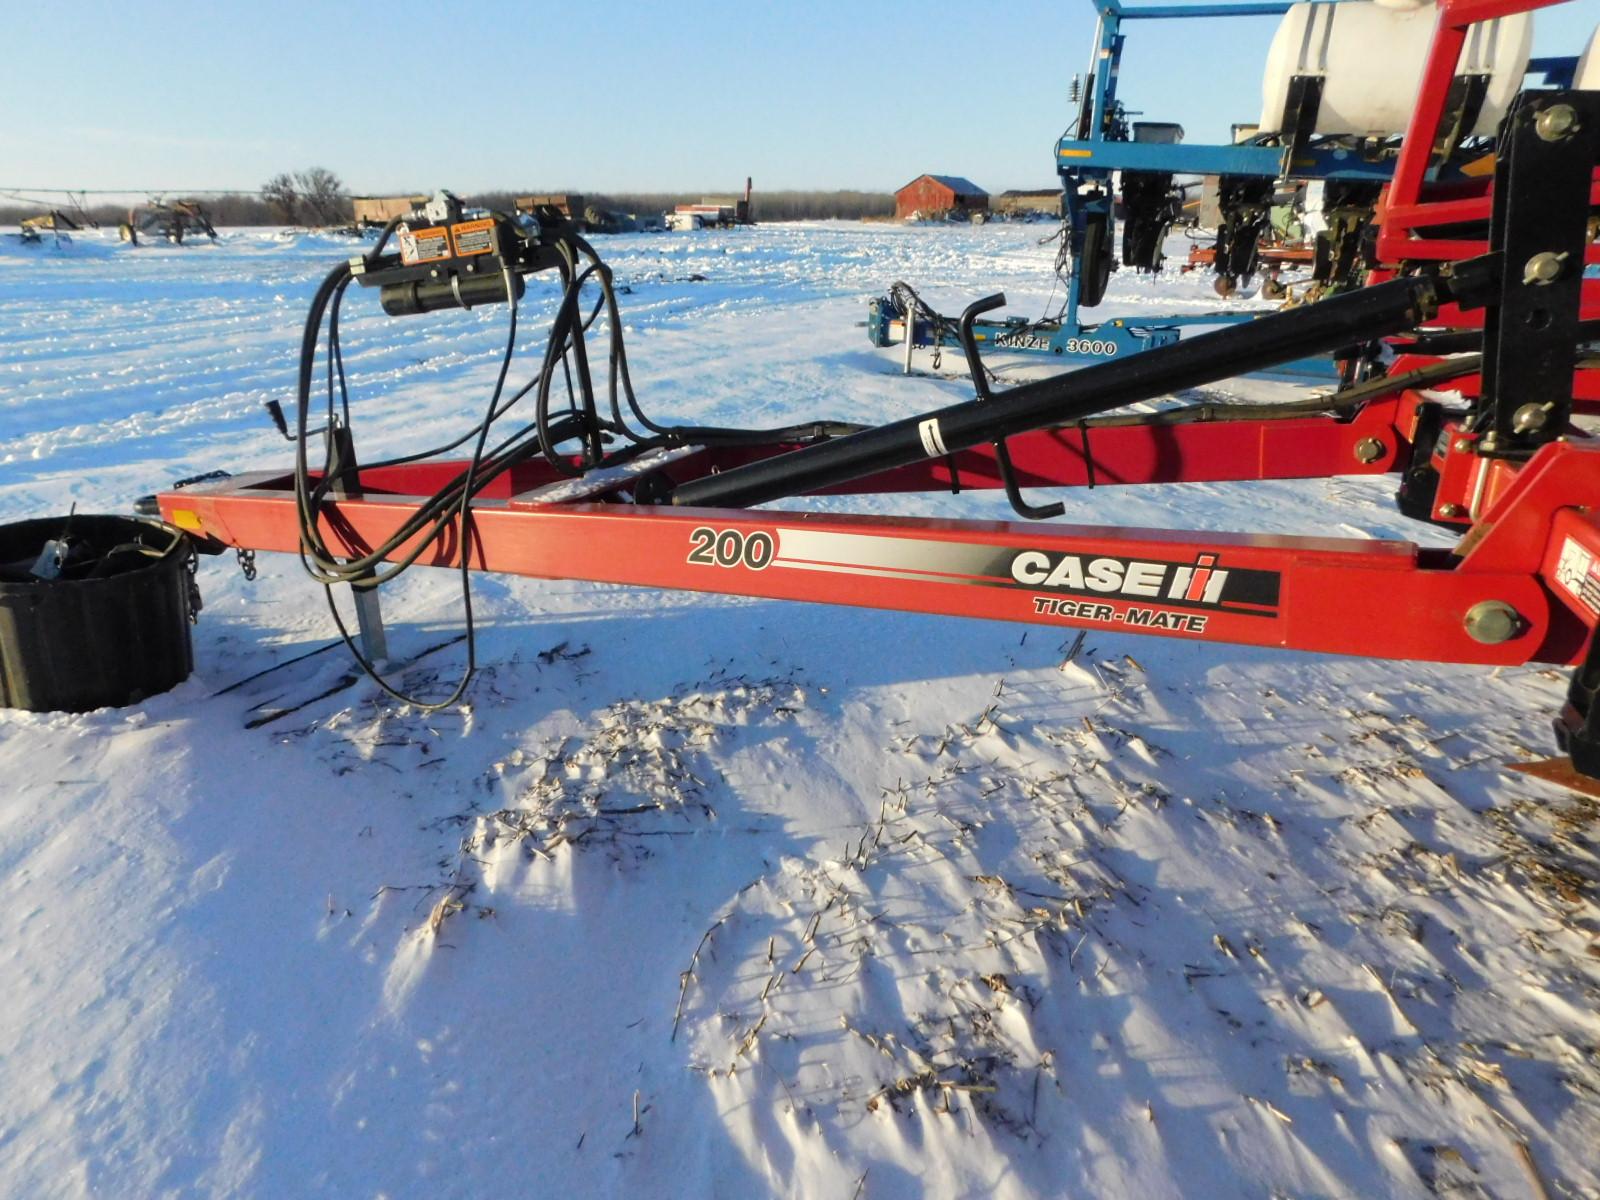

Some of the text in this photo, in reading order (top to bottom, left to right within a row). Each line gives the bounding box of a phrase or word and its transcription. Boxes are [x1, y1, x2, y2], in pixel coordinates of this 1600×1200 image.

[995, 332, 1117, 356] KINZE 3600
[686, 526, 774, 571] 200
[1011, 551, 1168, 597] CASE
[1033, 597, 1208, 633] TIGER-MATE
